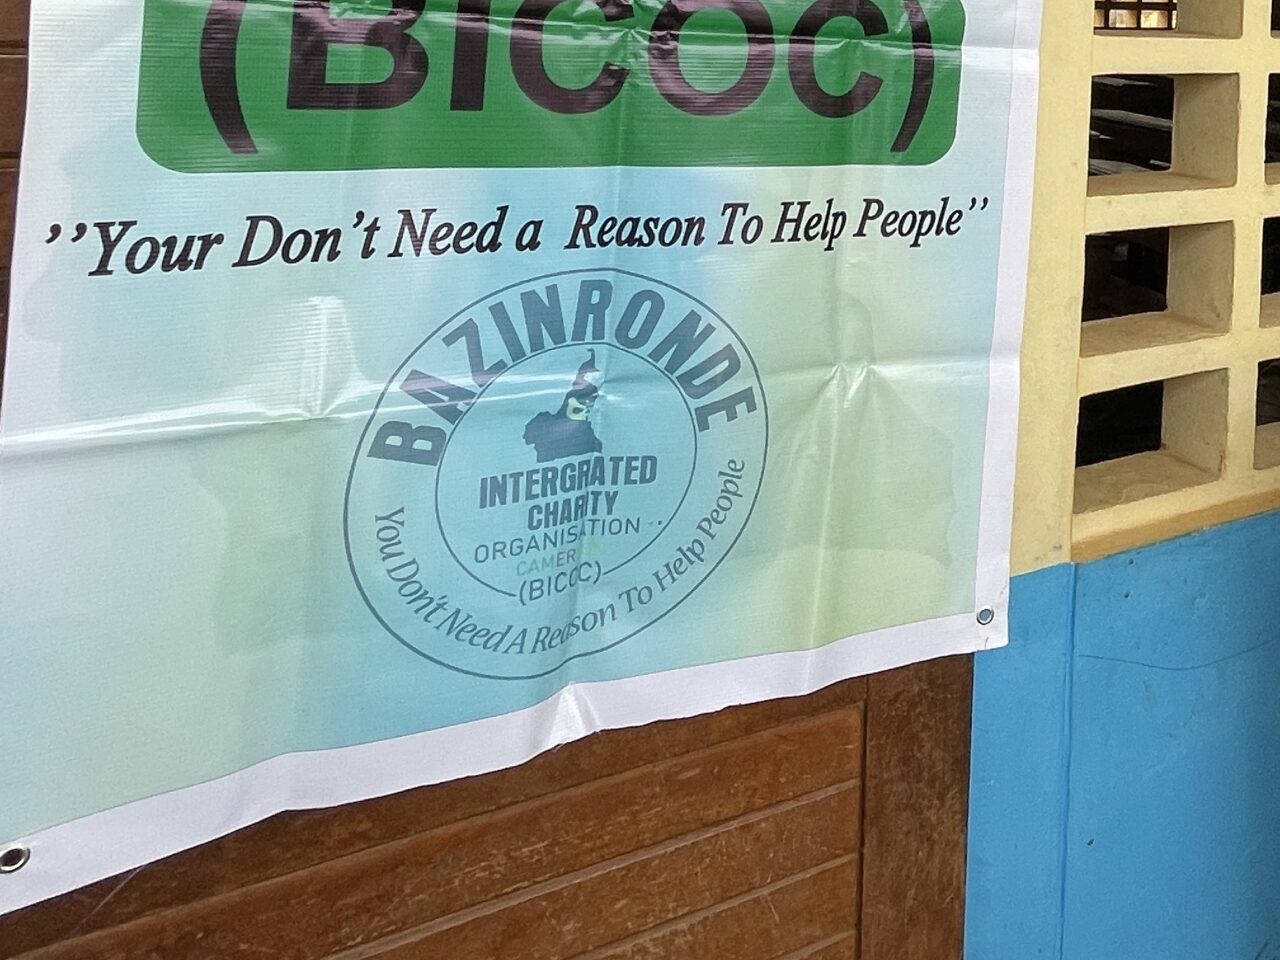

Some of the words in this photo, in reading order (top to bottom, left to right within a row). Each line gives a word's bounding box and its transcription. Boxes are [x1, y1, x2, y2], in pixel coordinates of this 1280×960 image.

[232, 209, 381, 268] Don't
[387, 205, 509, 258] Need
[514, 217, 543, 251] a
[564, 204, 706, 251] Reason
[717, 201, 764, 246] To
[770, 197, 848, 252] Help
[367, 278, 757, 468] BAZINRONDE
[479, 455, 658, 509] INTERGRATED
[697, 458, 745, 541] People
[375, 506, 405, 562] You
[528, 490, 619, 531] CHARITY
[474, 517, 641, 564] ORGANISATION
[652, 538, 706, 592] Help
[387, 557, 448, 624] Don't
[618, 585, 653, 614] To
[435, 607, 513, 653] Need
[501, 628, 528, 654] A
[529, 603, 616, 654] Reason
